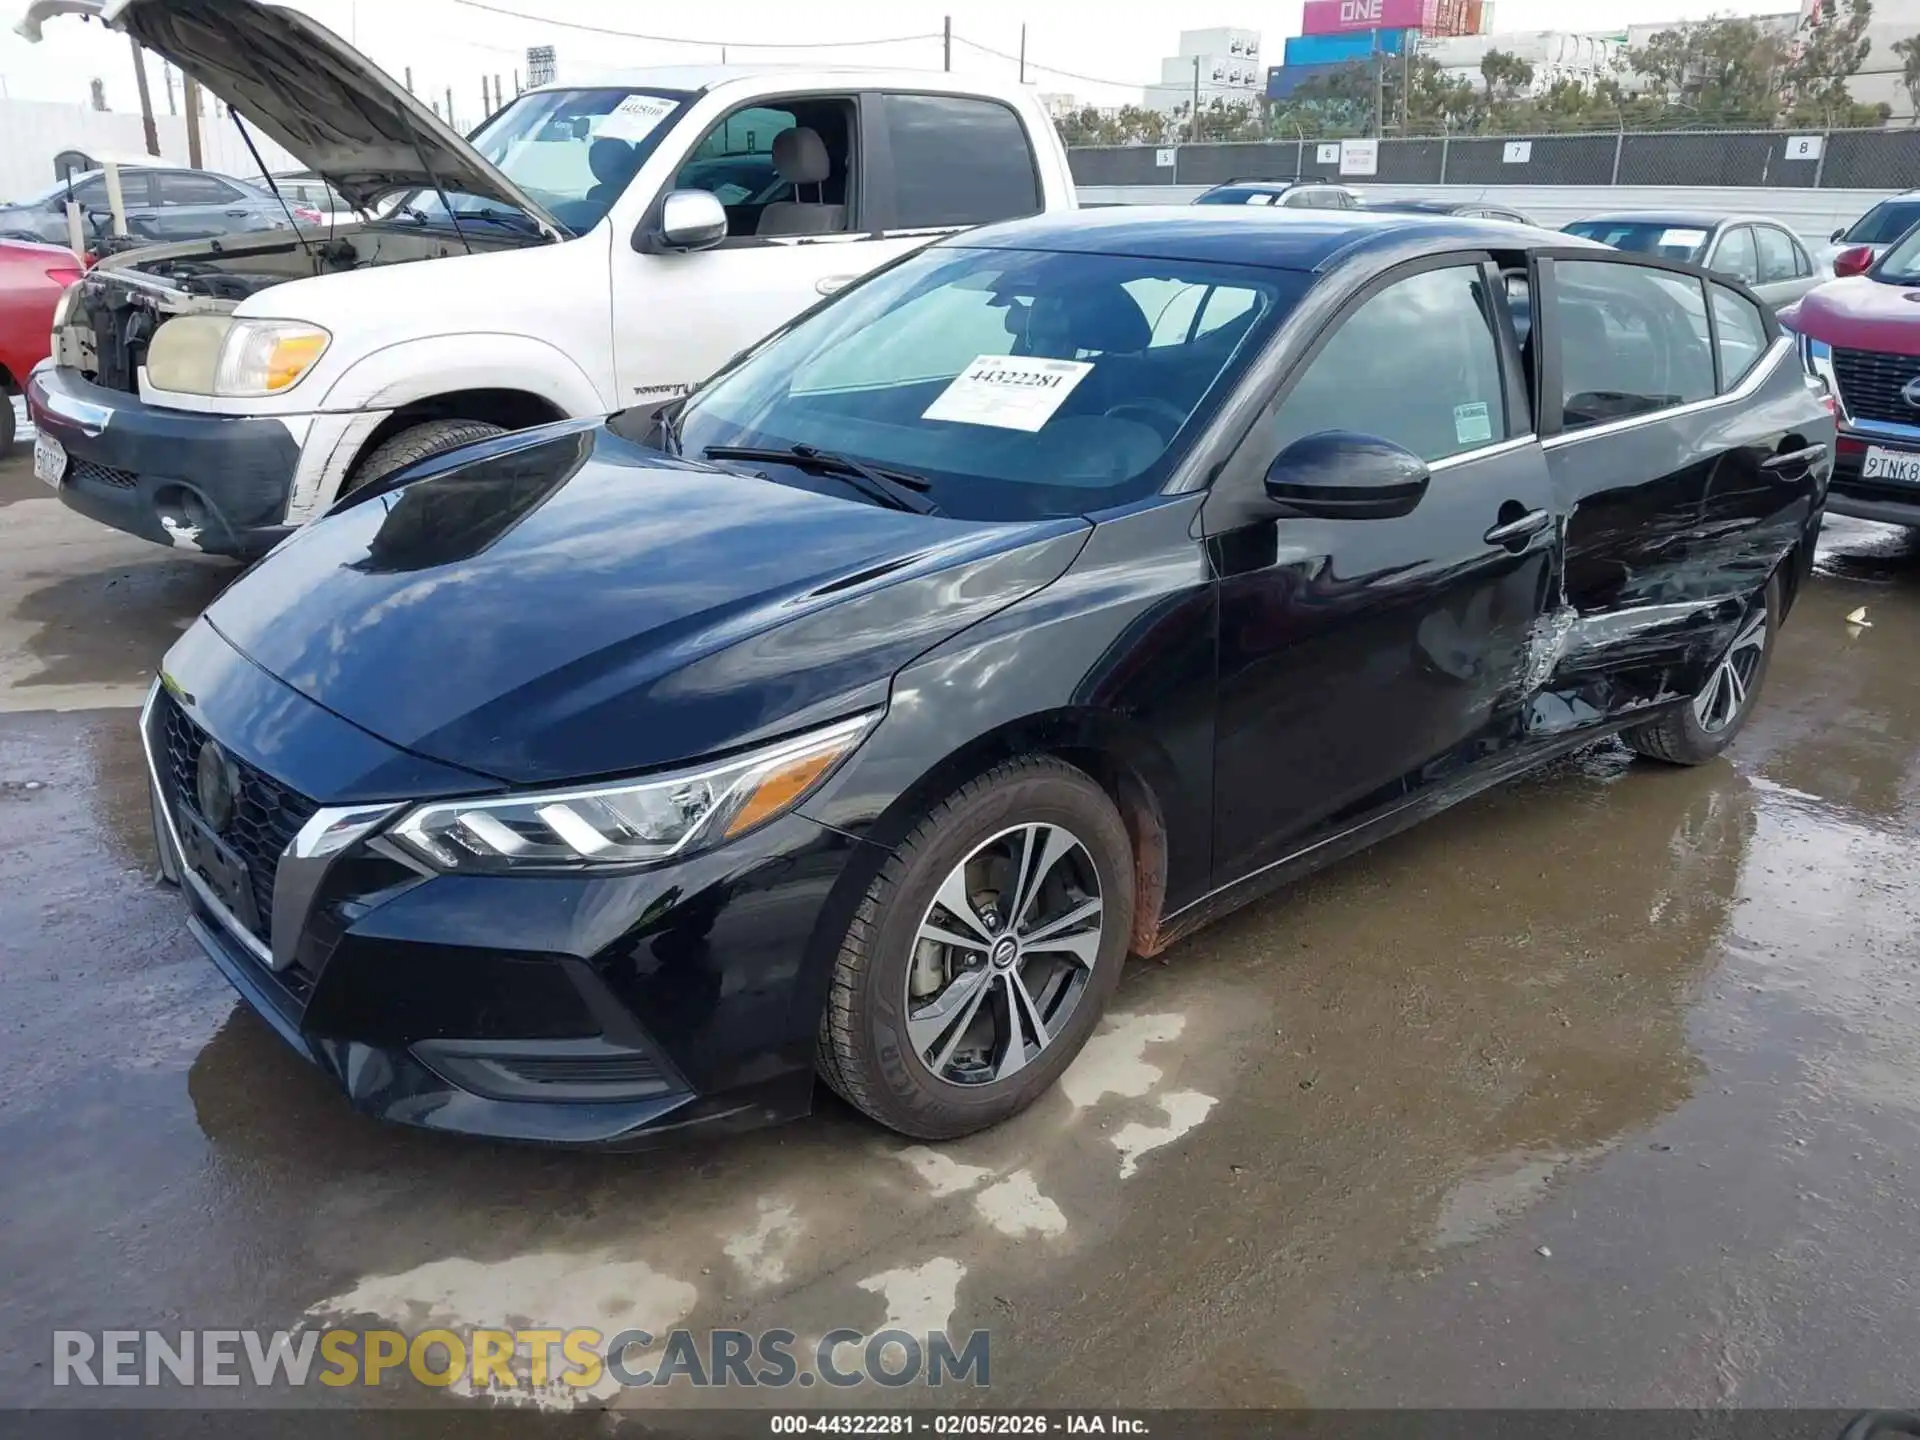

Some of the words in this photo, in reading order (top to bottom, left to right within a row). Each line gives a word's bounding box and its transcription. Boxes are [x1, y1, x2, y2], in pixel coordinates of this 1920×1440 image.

[1341, 0, 1382, 21] ONE
[1513, 147, 1521, 157] 7
[1799, 143, 1809, 153] 8
[969, 369, 1064, 389] 44322281
[1866, 457, 1920, 481] 9TNK8
